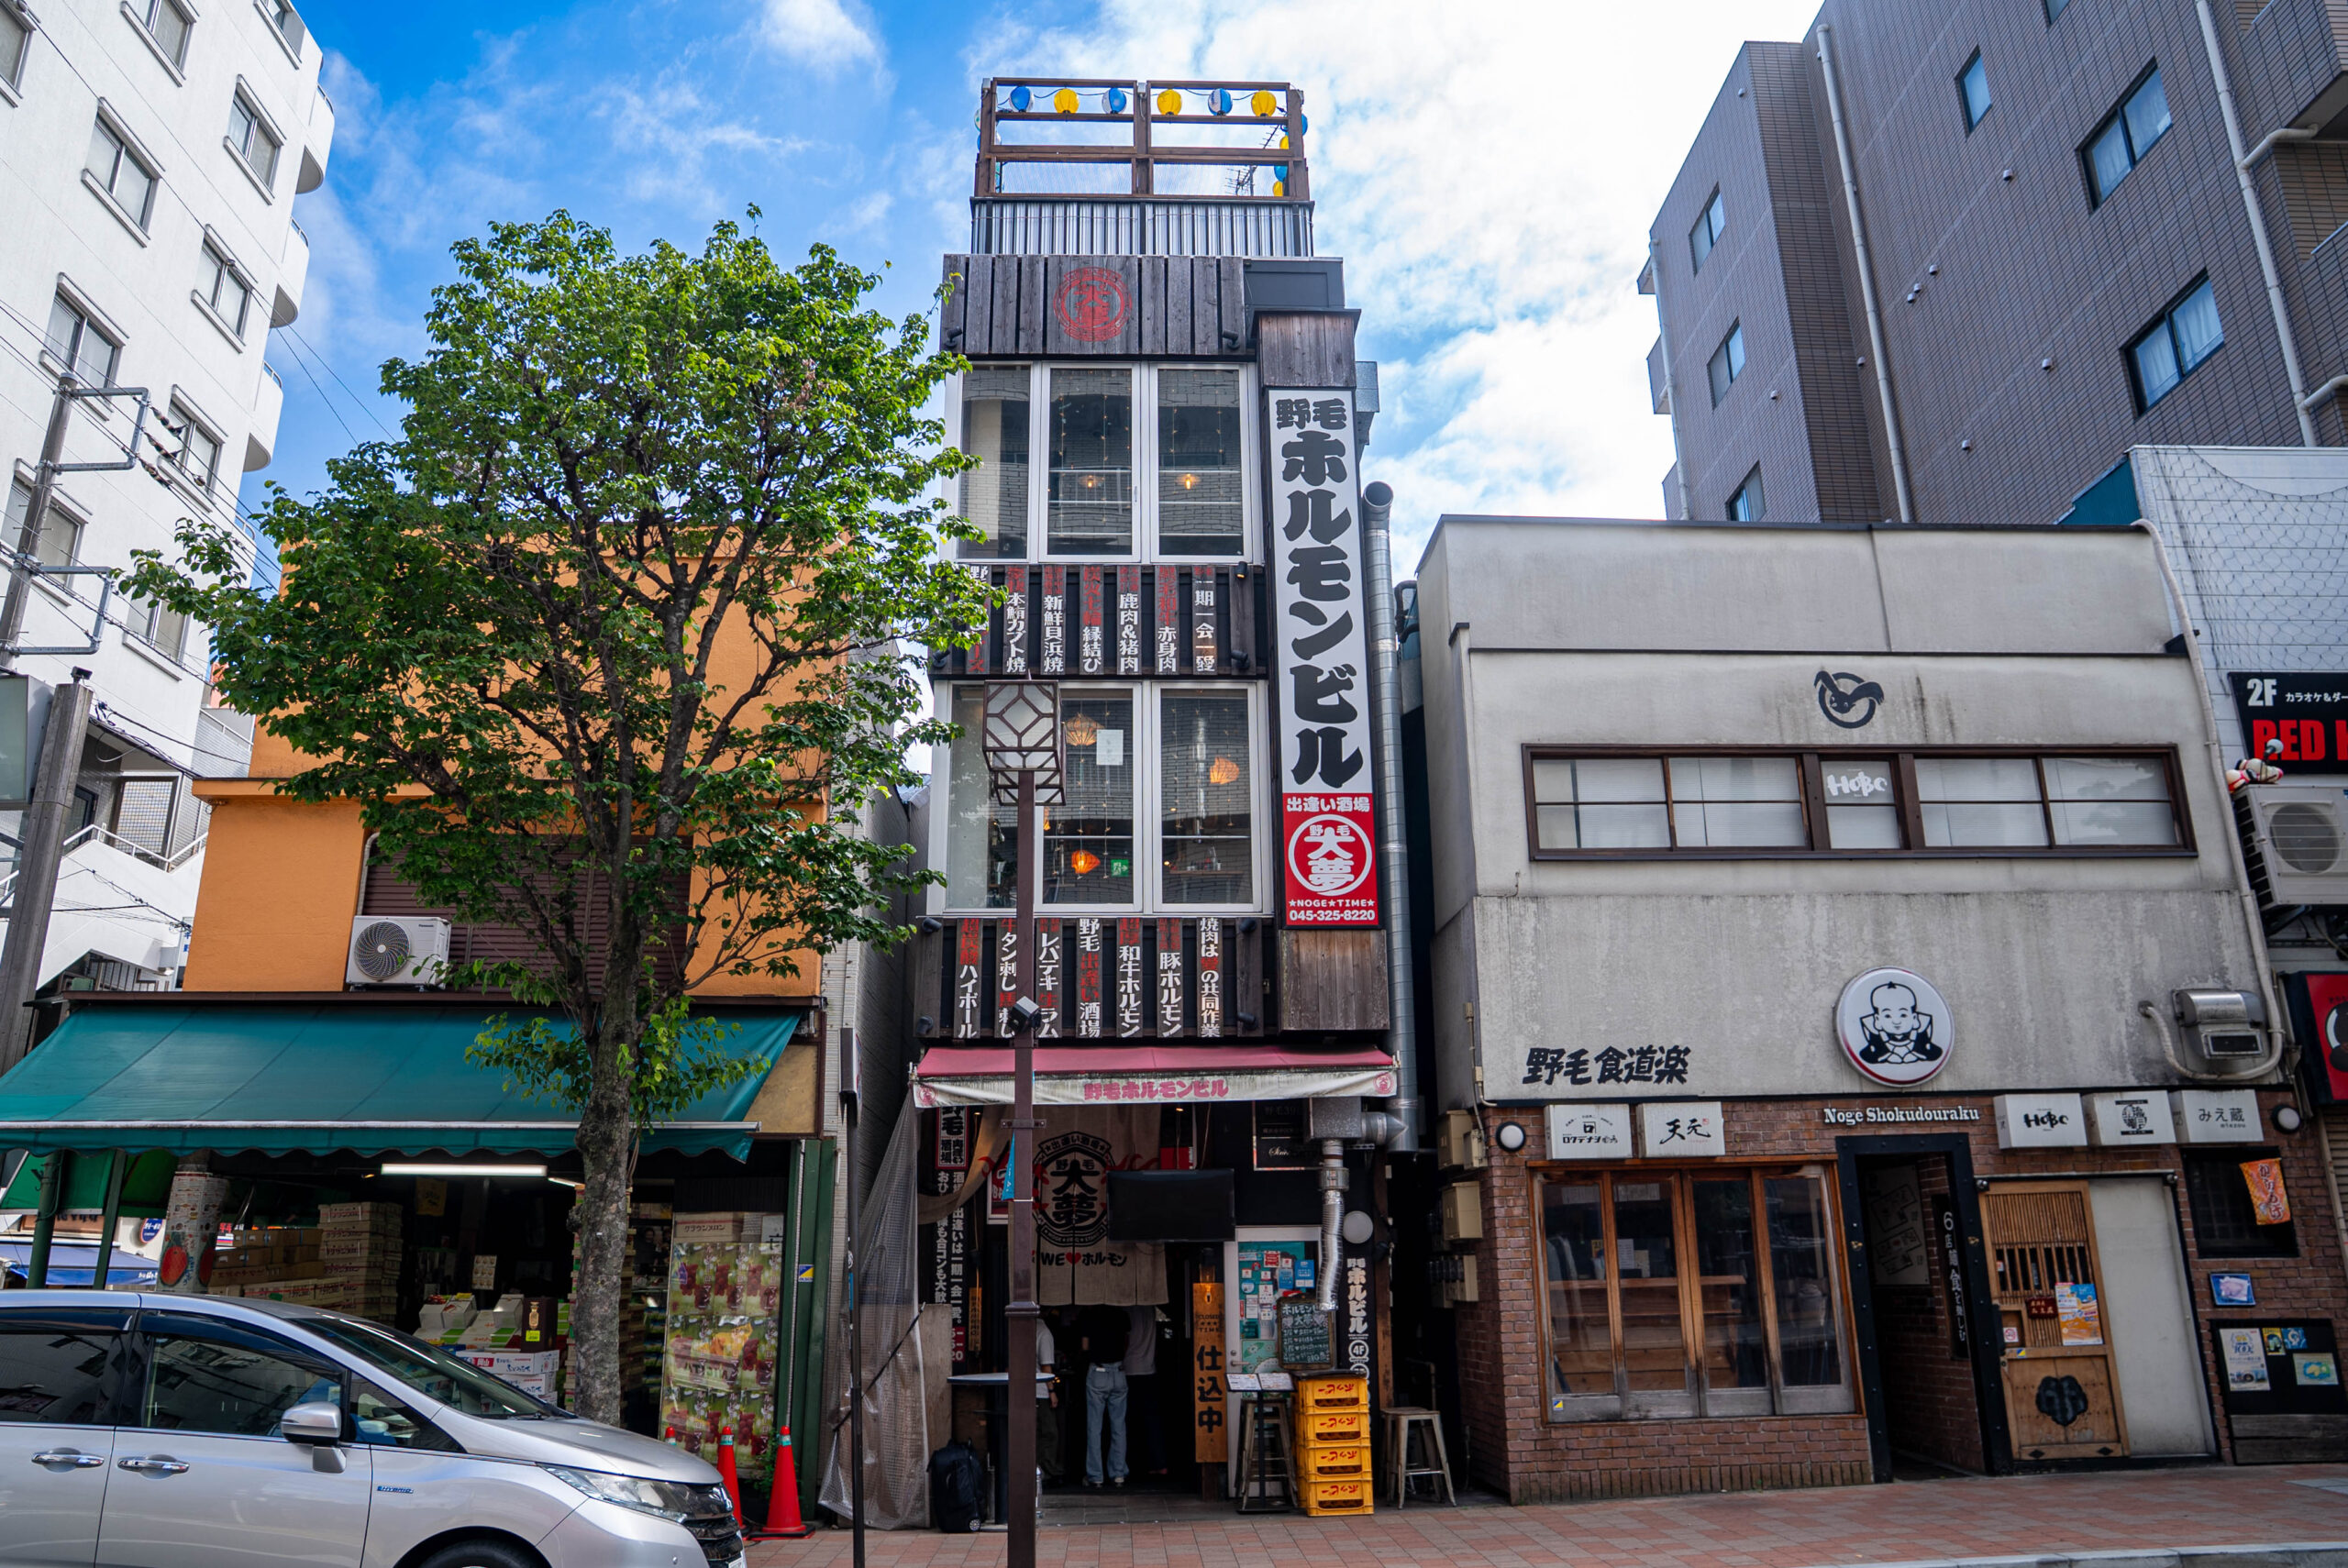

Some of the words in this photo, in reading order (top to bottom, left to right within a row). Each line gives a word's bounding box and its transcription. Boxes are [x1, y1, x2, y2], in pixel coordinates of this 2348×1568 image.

[1275, 398, 1347, 430] 野毛
[1280, 430, 1364, 789] ホルモンビル
[1044, 594, 1064, 673] 新鮮貝浜焼
[1119, 593, 1139, 673] 鹿肉&猪肉
[2247, 678, 2277, 707] 2F
[2252, 719, 2326, 762] RED
[1287, 797, 1370, 812] 出逢い酒場
[1289, 910, 1376, 922] 045-325-8220
[1297, 899, 1327, 908] NOGE
[1336, 899, 1368, 907] TIME
[1159, 952, 1182, 1037] 豚ホルモン
[1523, 1044, 1691, 1086] 野毛食道楽
[1084, 1079, 1229, 1100] 野毛ホルモンビル
[1823, 1108, 1864, 1126] Noge
[1866, 1106, 1980, 1122] Shokudouraku
[2198, 1108, 2245, 1122] みえ蔵
[1041, 1253, 1066, 1265] WE
[1082, 1252, 1127, 1267] ホルモン
[1352, 1345, 1365, 1354] 4F
[1196, 1345, 1224, 1433] 仕込中
